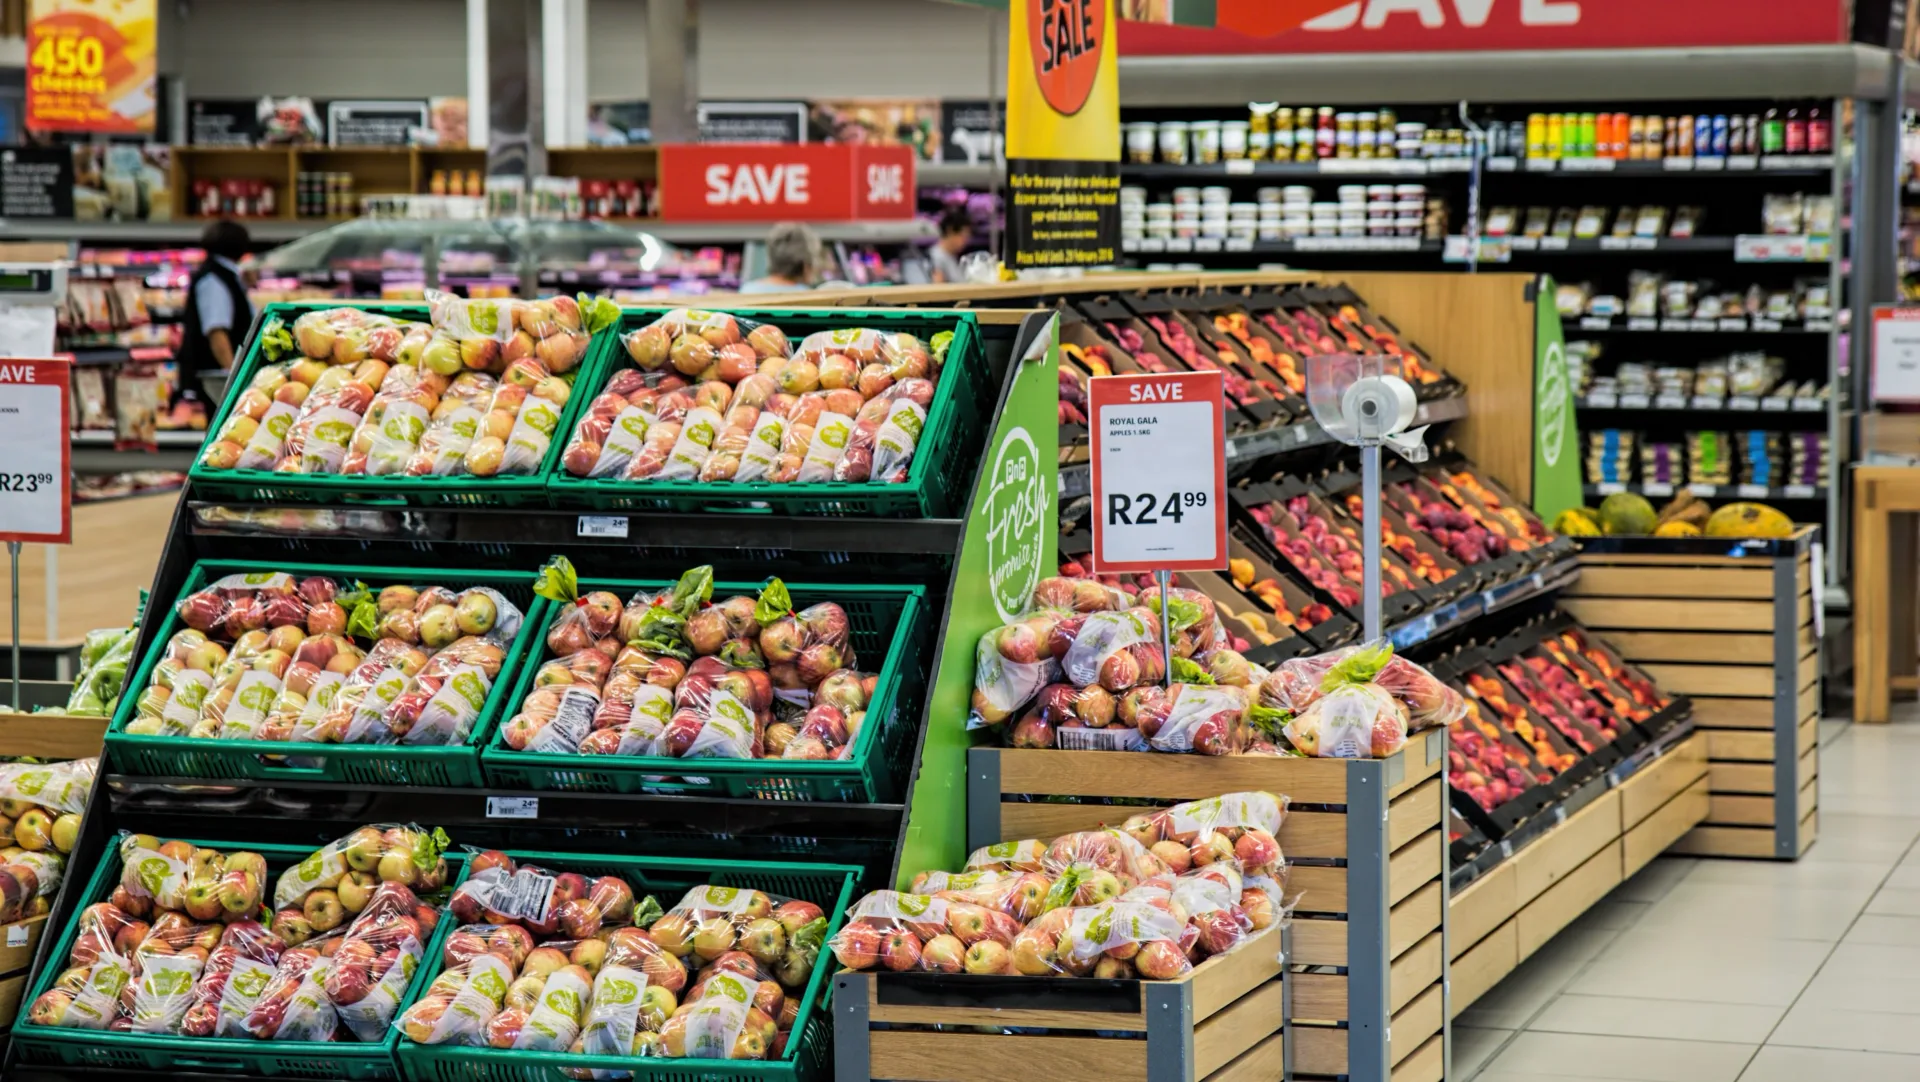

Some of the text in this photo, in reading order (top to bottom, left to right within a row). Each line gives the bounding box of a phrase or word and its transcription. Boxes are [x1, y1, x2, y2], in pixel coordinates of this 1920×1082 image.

[1041, 0, 1095, 75] SALE
[32, 36, 104, 76] 450
[706, 163, 810, 205] SAVE
[867, 164, 903, 204] SAVE
[1014, 191, 1036, 205] discover
[1034, 174, 1044, 188] the
[1110, 174, 1120, 188] and
[1016, 250, 1034, 265] Prices
[1129, 382, 1183, 402] SAVE
[1109, 416, 1158, 426] ROYAL GALA
[1109, 429, 1132, 437] APPLES
[1006, 456, 1027, 484] PnP
[982, 447, 1051, 556] Fresh
[990, 544, 1031, 604] promise
[1007, 596, 1018, 610] your
[1018, 569, 1033, 605] money
